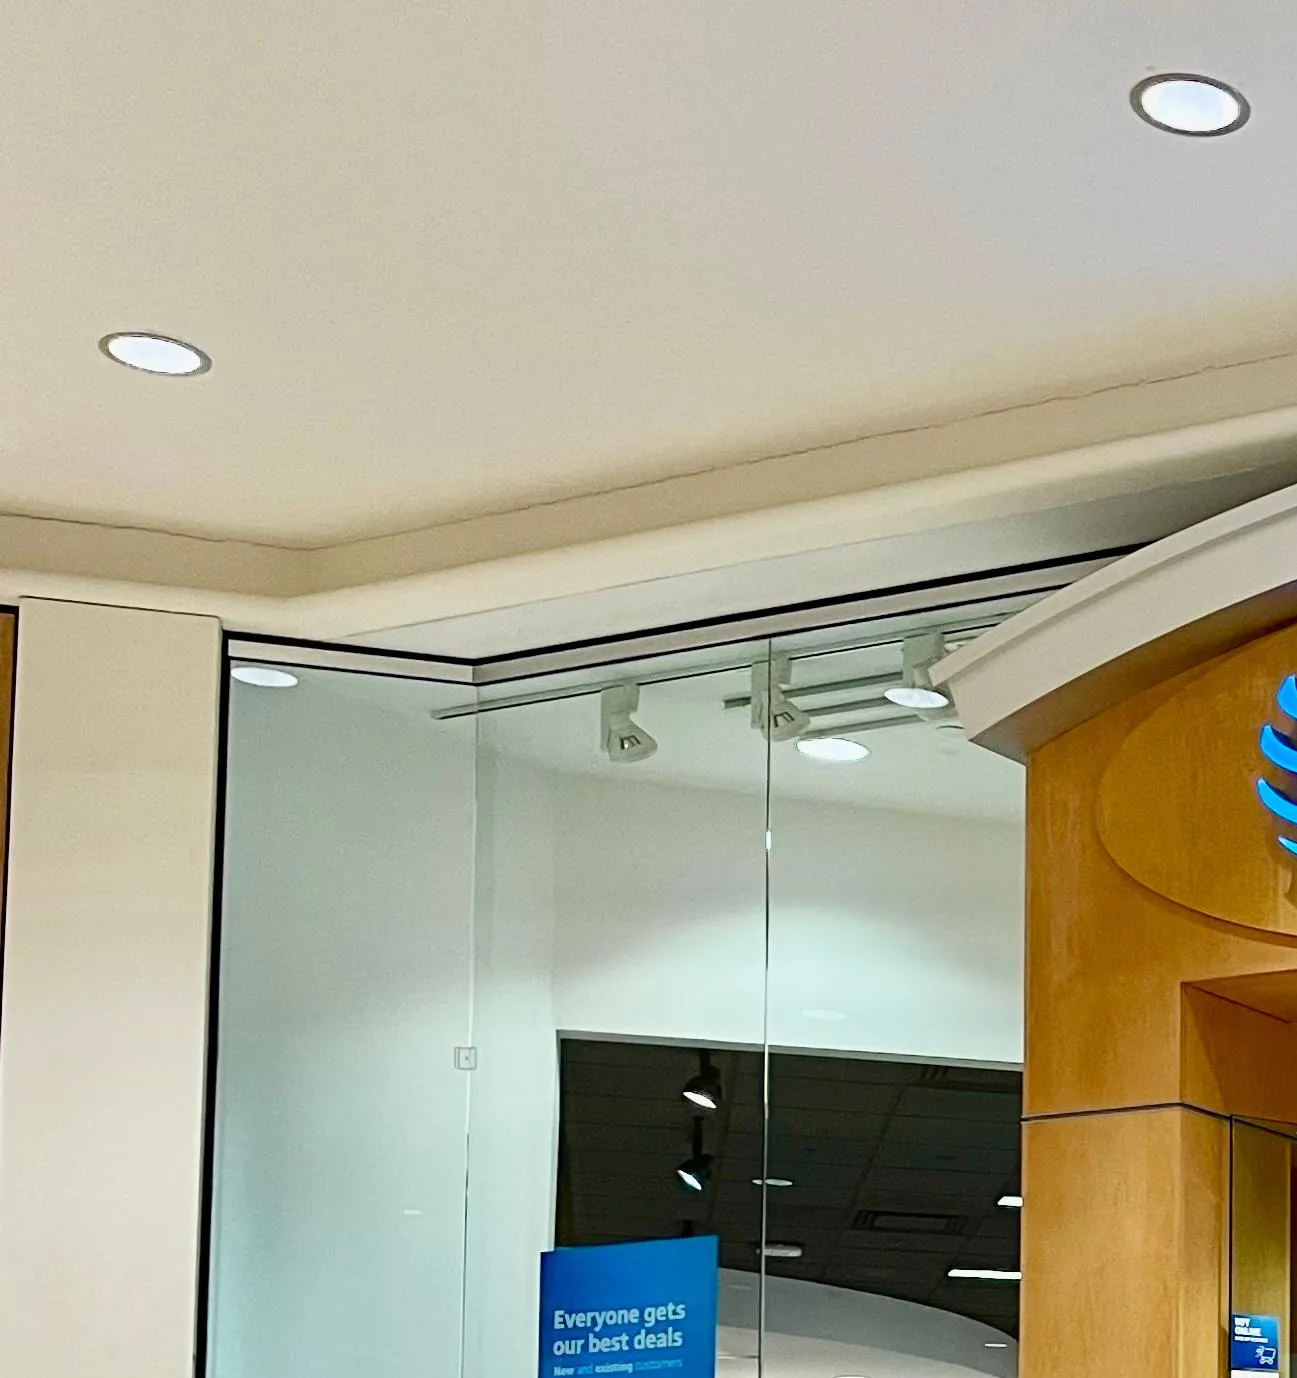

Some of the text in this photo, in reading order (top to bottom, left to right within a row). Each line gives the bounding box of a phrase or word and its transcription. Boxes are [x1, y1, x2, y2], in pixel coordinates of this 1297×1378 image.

[553, 1302, 686, 1331] Everyone gets
[553, 1327, 683, 1355] our best deals
[554, 1366, 575, 1376] New
